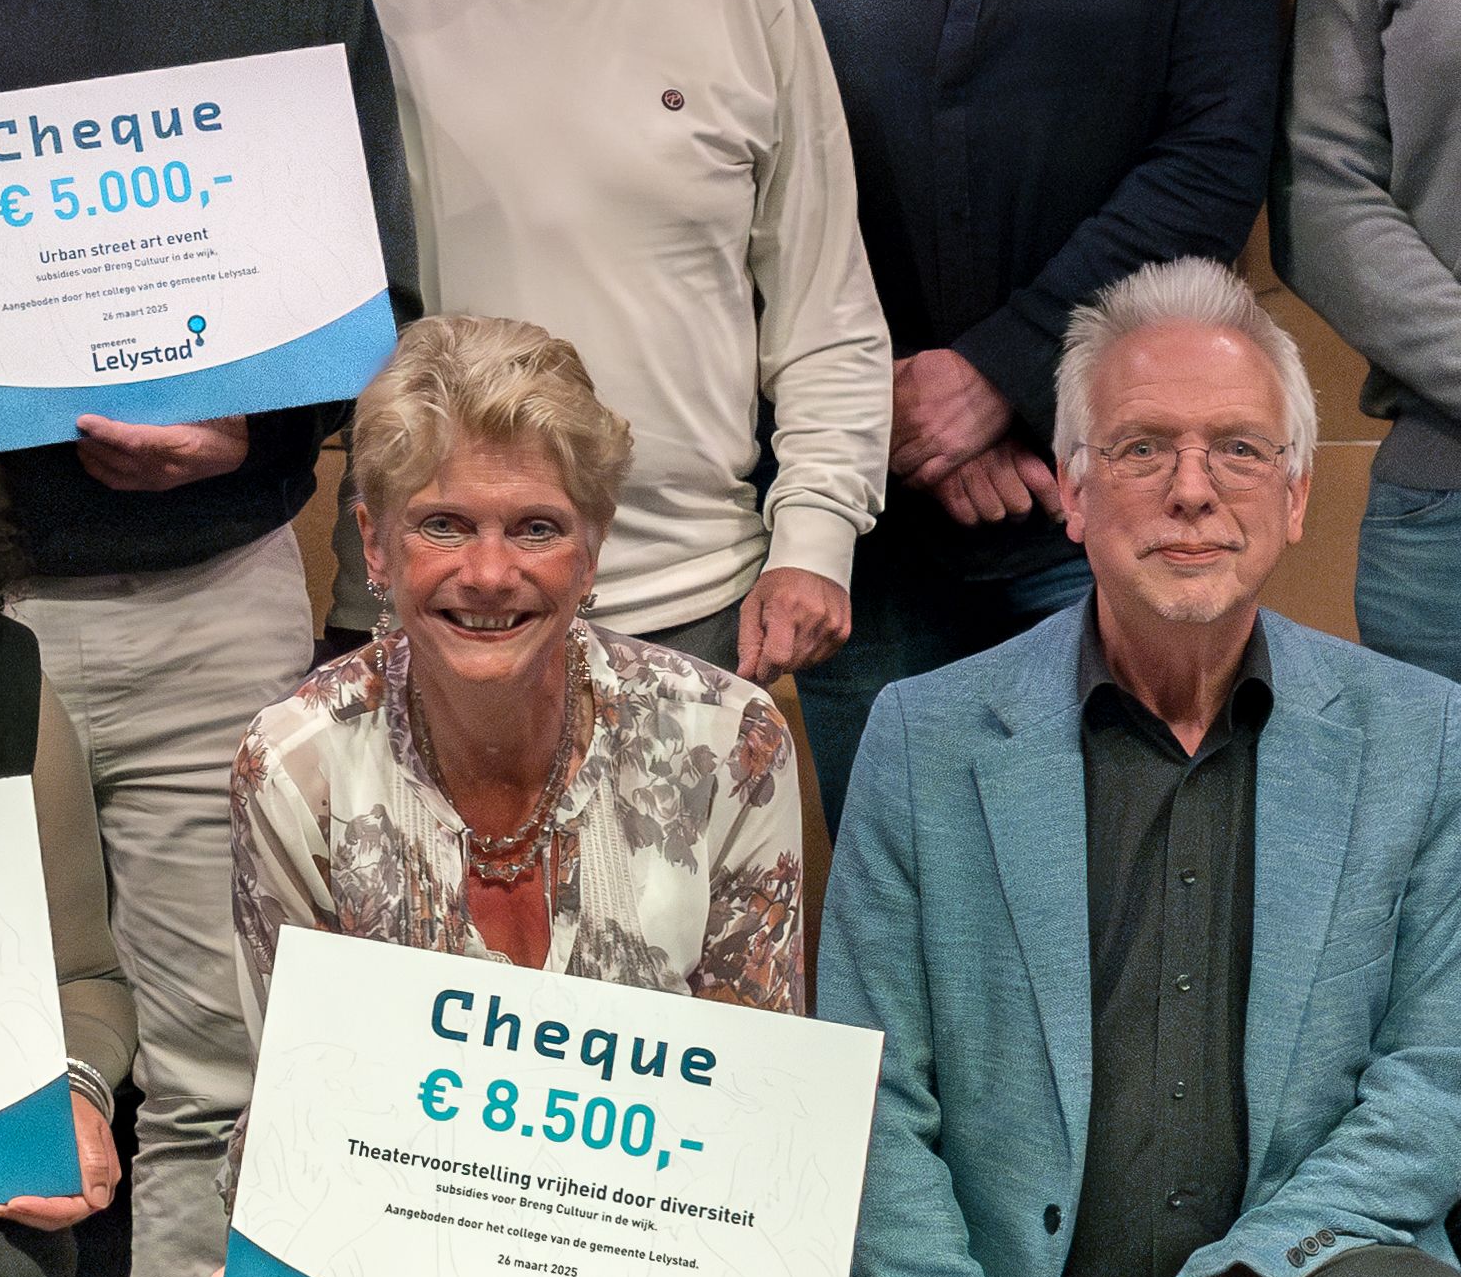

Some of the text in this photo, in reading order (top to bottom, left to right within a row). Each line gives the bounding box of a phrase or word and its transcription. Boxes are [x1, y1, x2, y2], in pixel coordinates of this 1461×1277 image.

[49, 160, 233, 221] 5.000,-
[39, 227, 209, 264] Urban street art event
[102, 303, 169, 322] 26 maart 2025
[90, 337, 137, 352] gemeente
[91, 338, 193, 373] Lelystad
[430, 988, 717, 1087] Cheque
[416, 1067, 705, 1172] € 8.500,-
[347, 1138, 756, 1228] Theatervoorstelling vrijheid door diversiteit
[435, 1183, 658, 1232] subsidies voor Breng Cultuur in de wijk.
[383, 1203, 700, 1270] Aangeboden door het college van de gemeente Lelystad.
[497, 1253, 512, 1267] 26
[513, 1258, 549, 1273] maart
